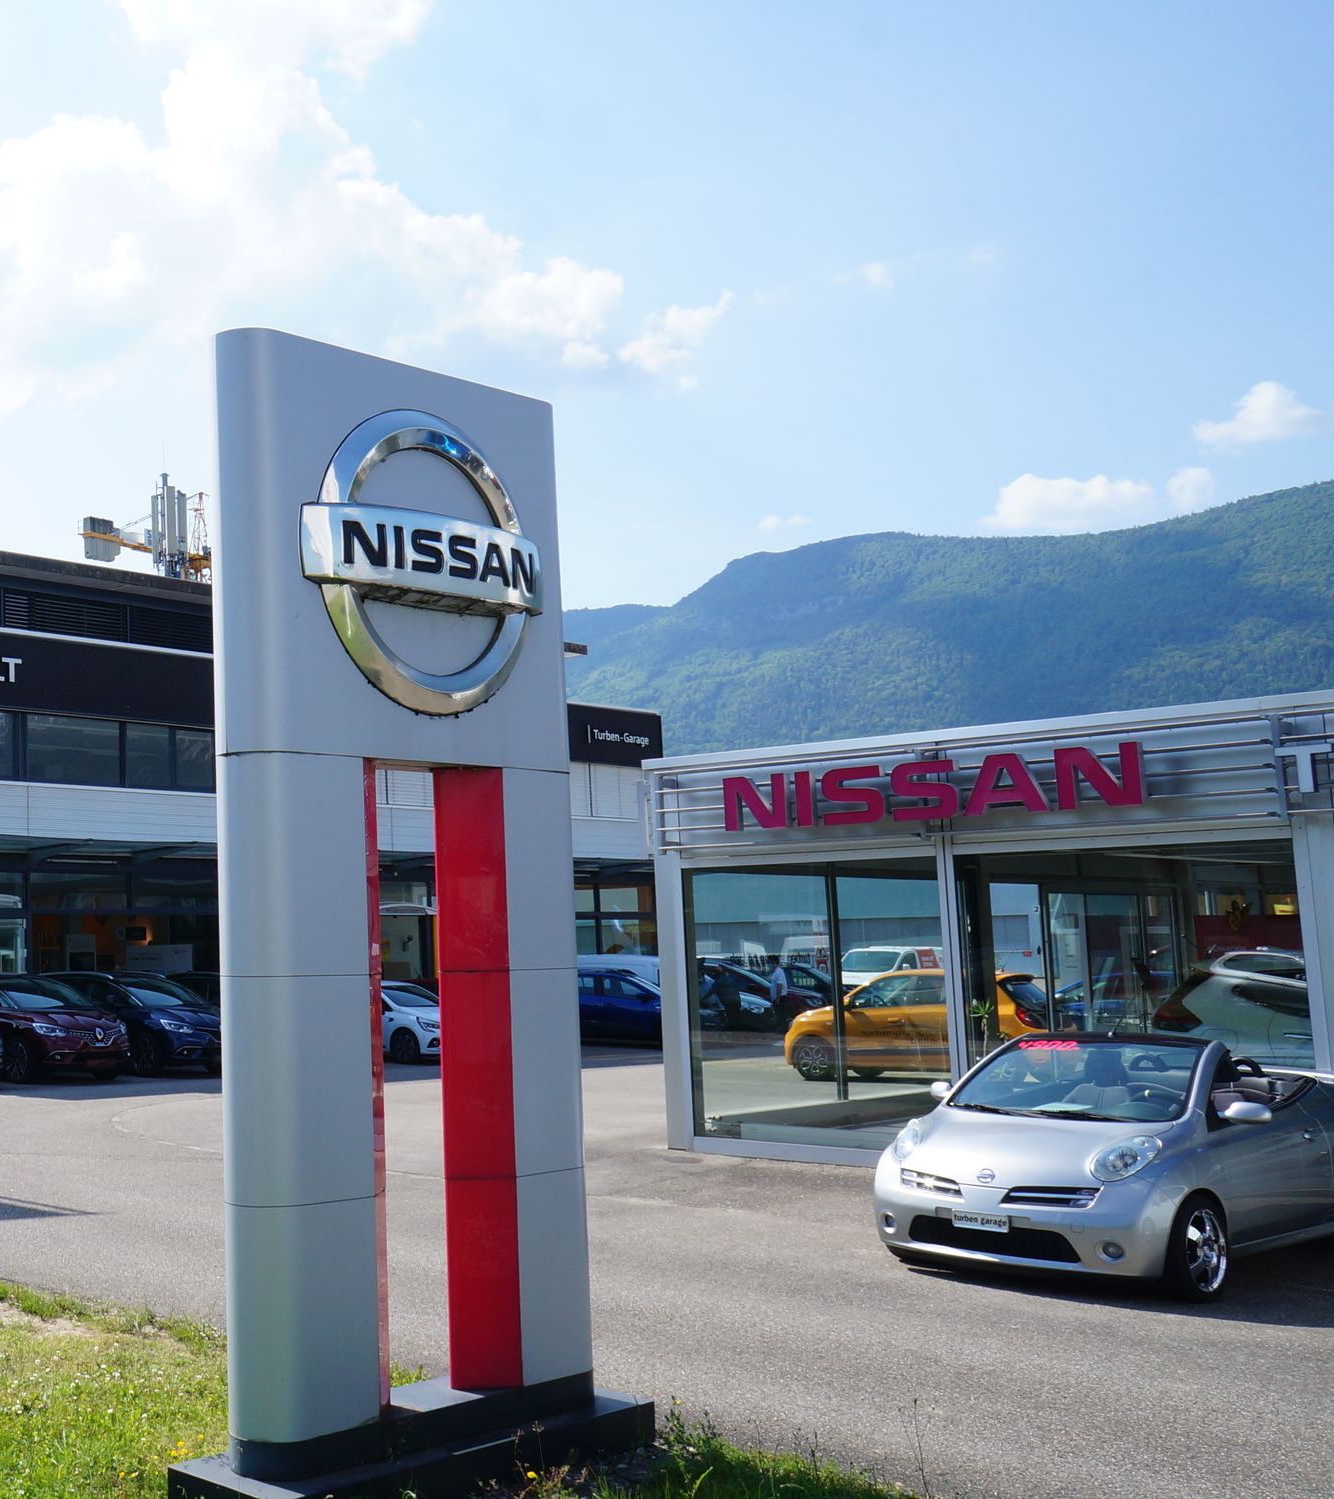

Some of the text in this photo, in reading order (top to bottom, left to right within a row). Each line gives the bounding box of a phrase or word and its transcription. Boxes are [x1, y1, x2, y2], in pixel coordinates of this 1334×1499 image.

[342, 520, 536, 594] NISSAN
[721, 741, 1147, 832] NISSAN
[954, 1213, 1008, 1227] turben garage
